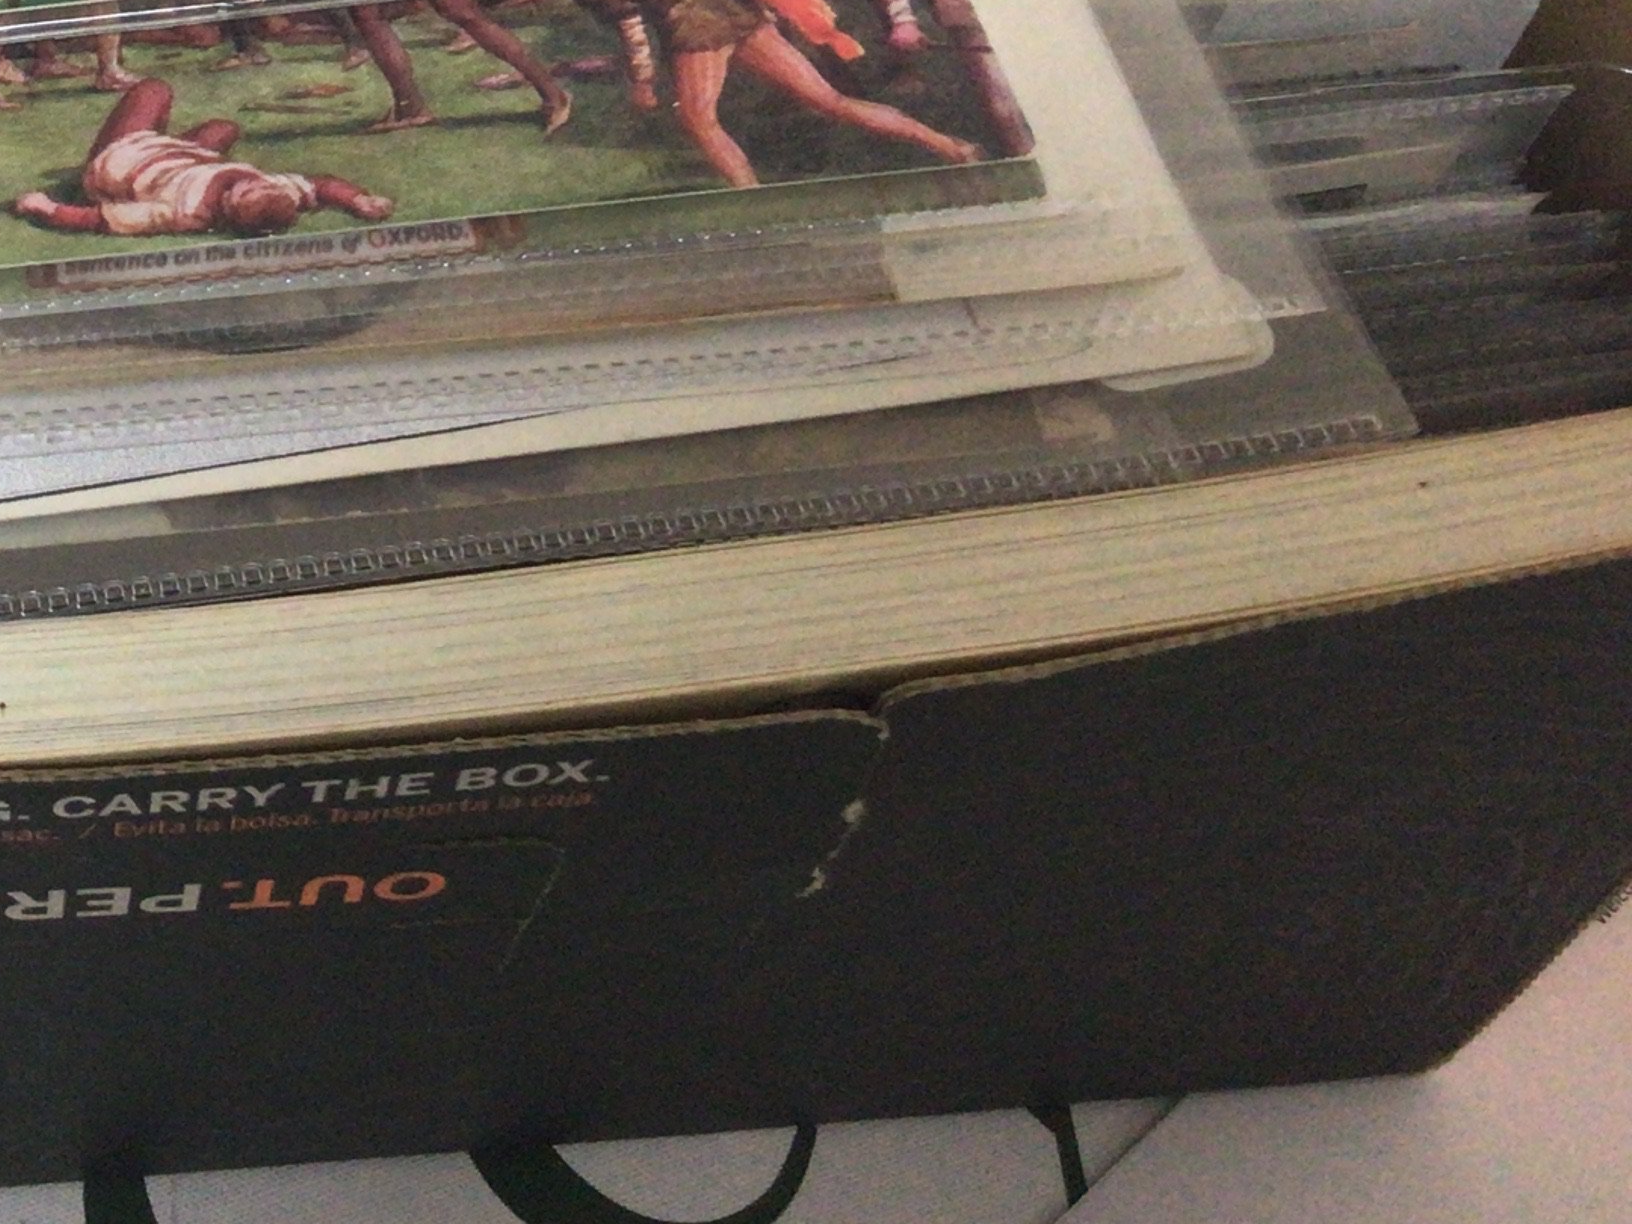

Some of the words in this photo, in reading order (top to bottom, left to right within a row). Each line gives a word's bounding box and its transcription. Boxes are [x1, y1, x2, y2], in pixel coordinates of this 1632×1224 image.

[52, 782, 285, 818] CARRY
[301, 771, 434, 803] THE
[455, 759, 610, 792] BOX.
